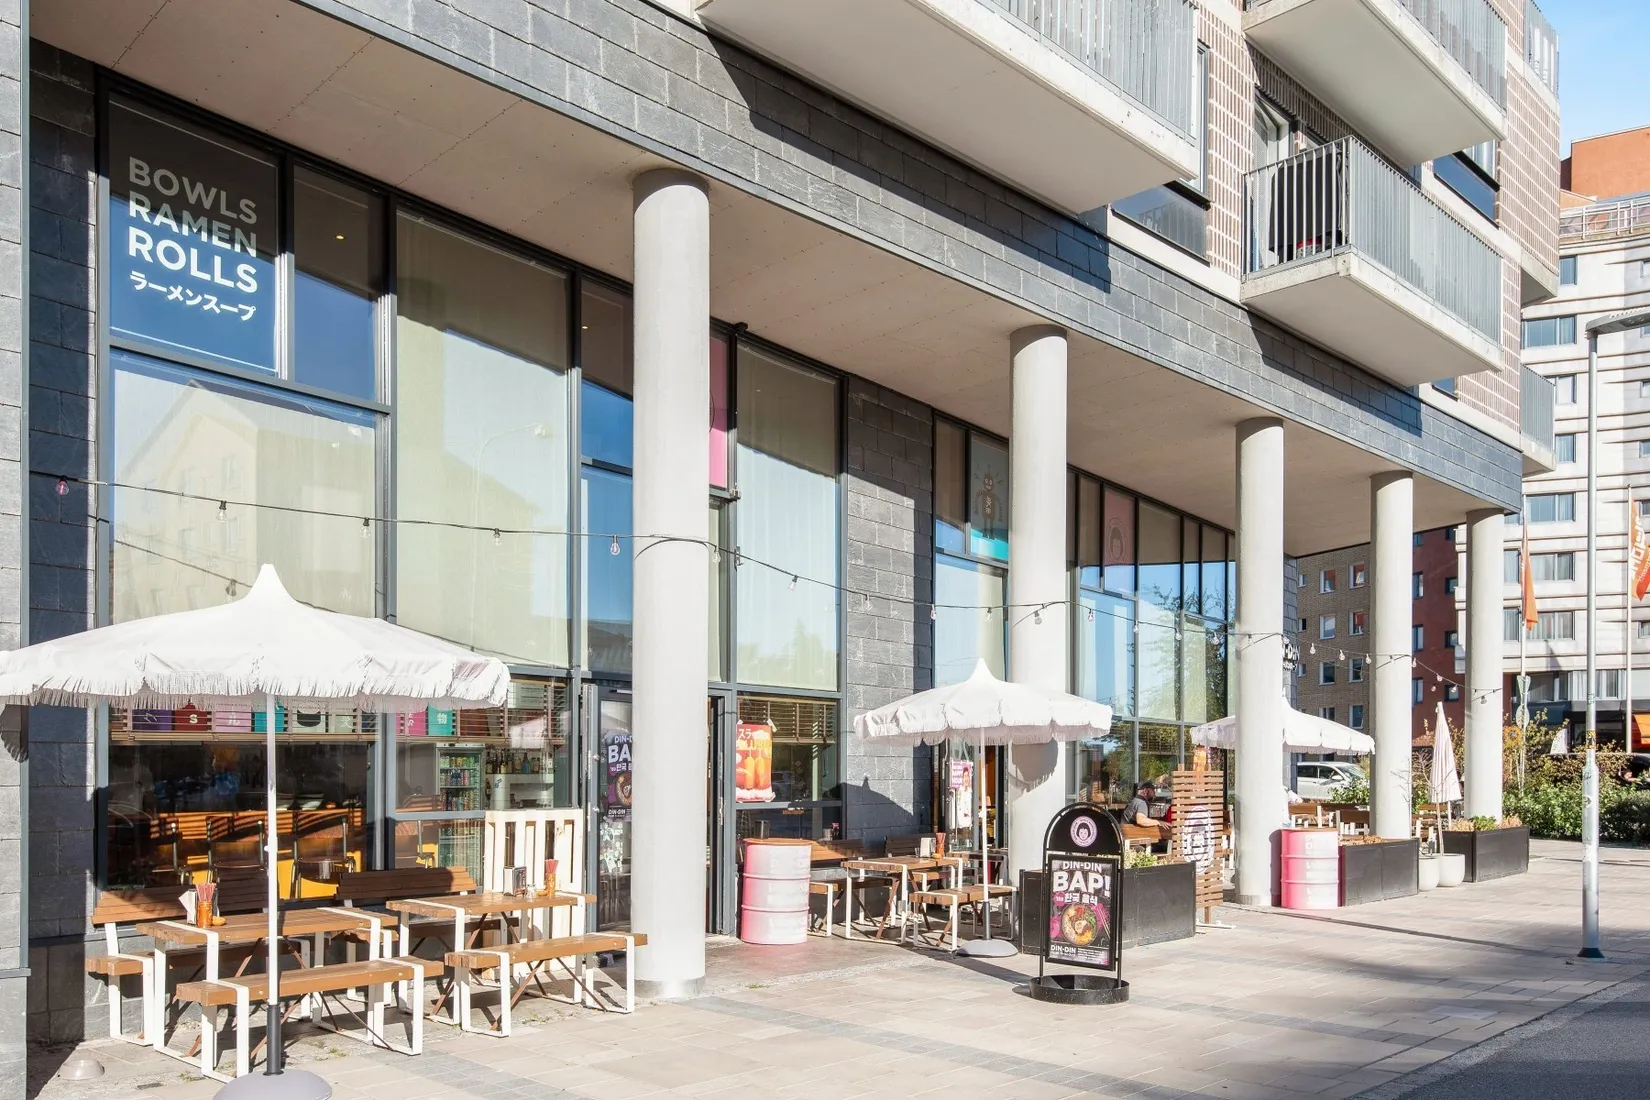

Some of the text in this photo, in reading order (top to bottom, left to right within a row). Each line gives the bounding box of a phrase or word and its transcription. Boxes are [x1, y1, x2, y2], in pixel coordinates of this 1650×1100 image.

[129, 156, 257, 225] BOWLS
[129, 190, 257, 258] RAMEN
[128, 225, 258, 293] ROLLS
[130, 270, 257, 321] ラーメンスープ
[608, 743, 632, 763] BA
[1053, 870, 1111, 897] BAP!
[1062, 861, 1102, 873] DIN-DIN
[1050, 944, 1077, 954] DIN-DIN
